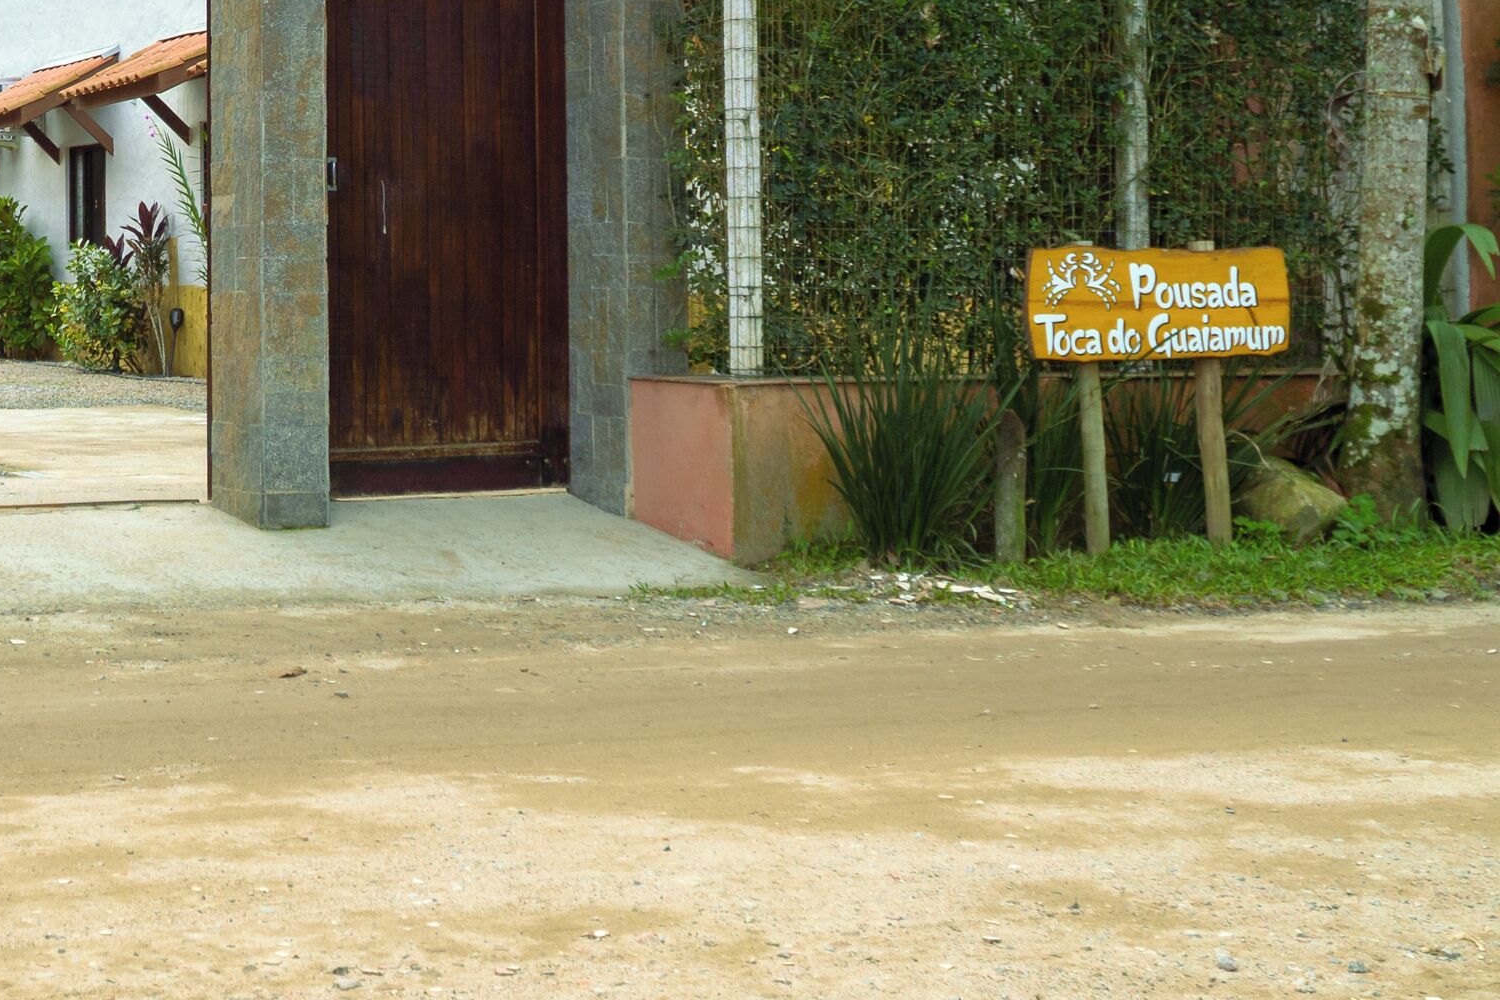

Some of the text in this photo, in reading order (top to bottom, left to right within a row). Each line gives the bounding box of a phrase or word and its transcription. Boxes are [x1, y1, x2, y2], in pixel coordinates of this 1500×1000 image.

[1129, 262, 1257, 309] Pousada
[1033, 313, 1285, 358] Toca do Guaiamum
